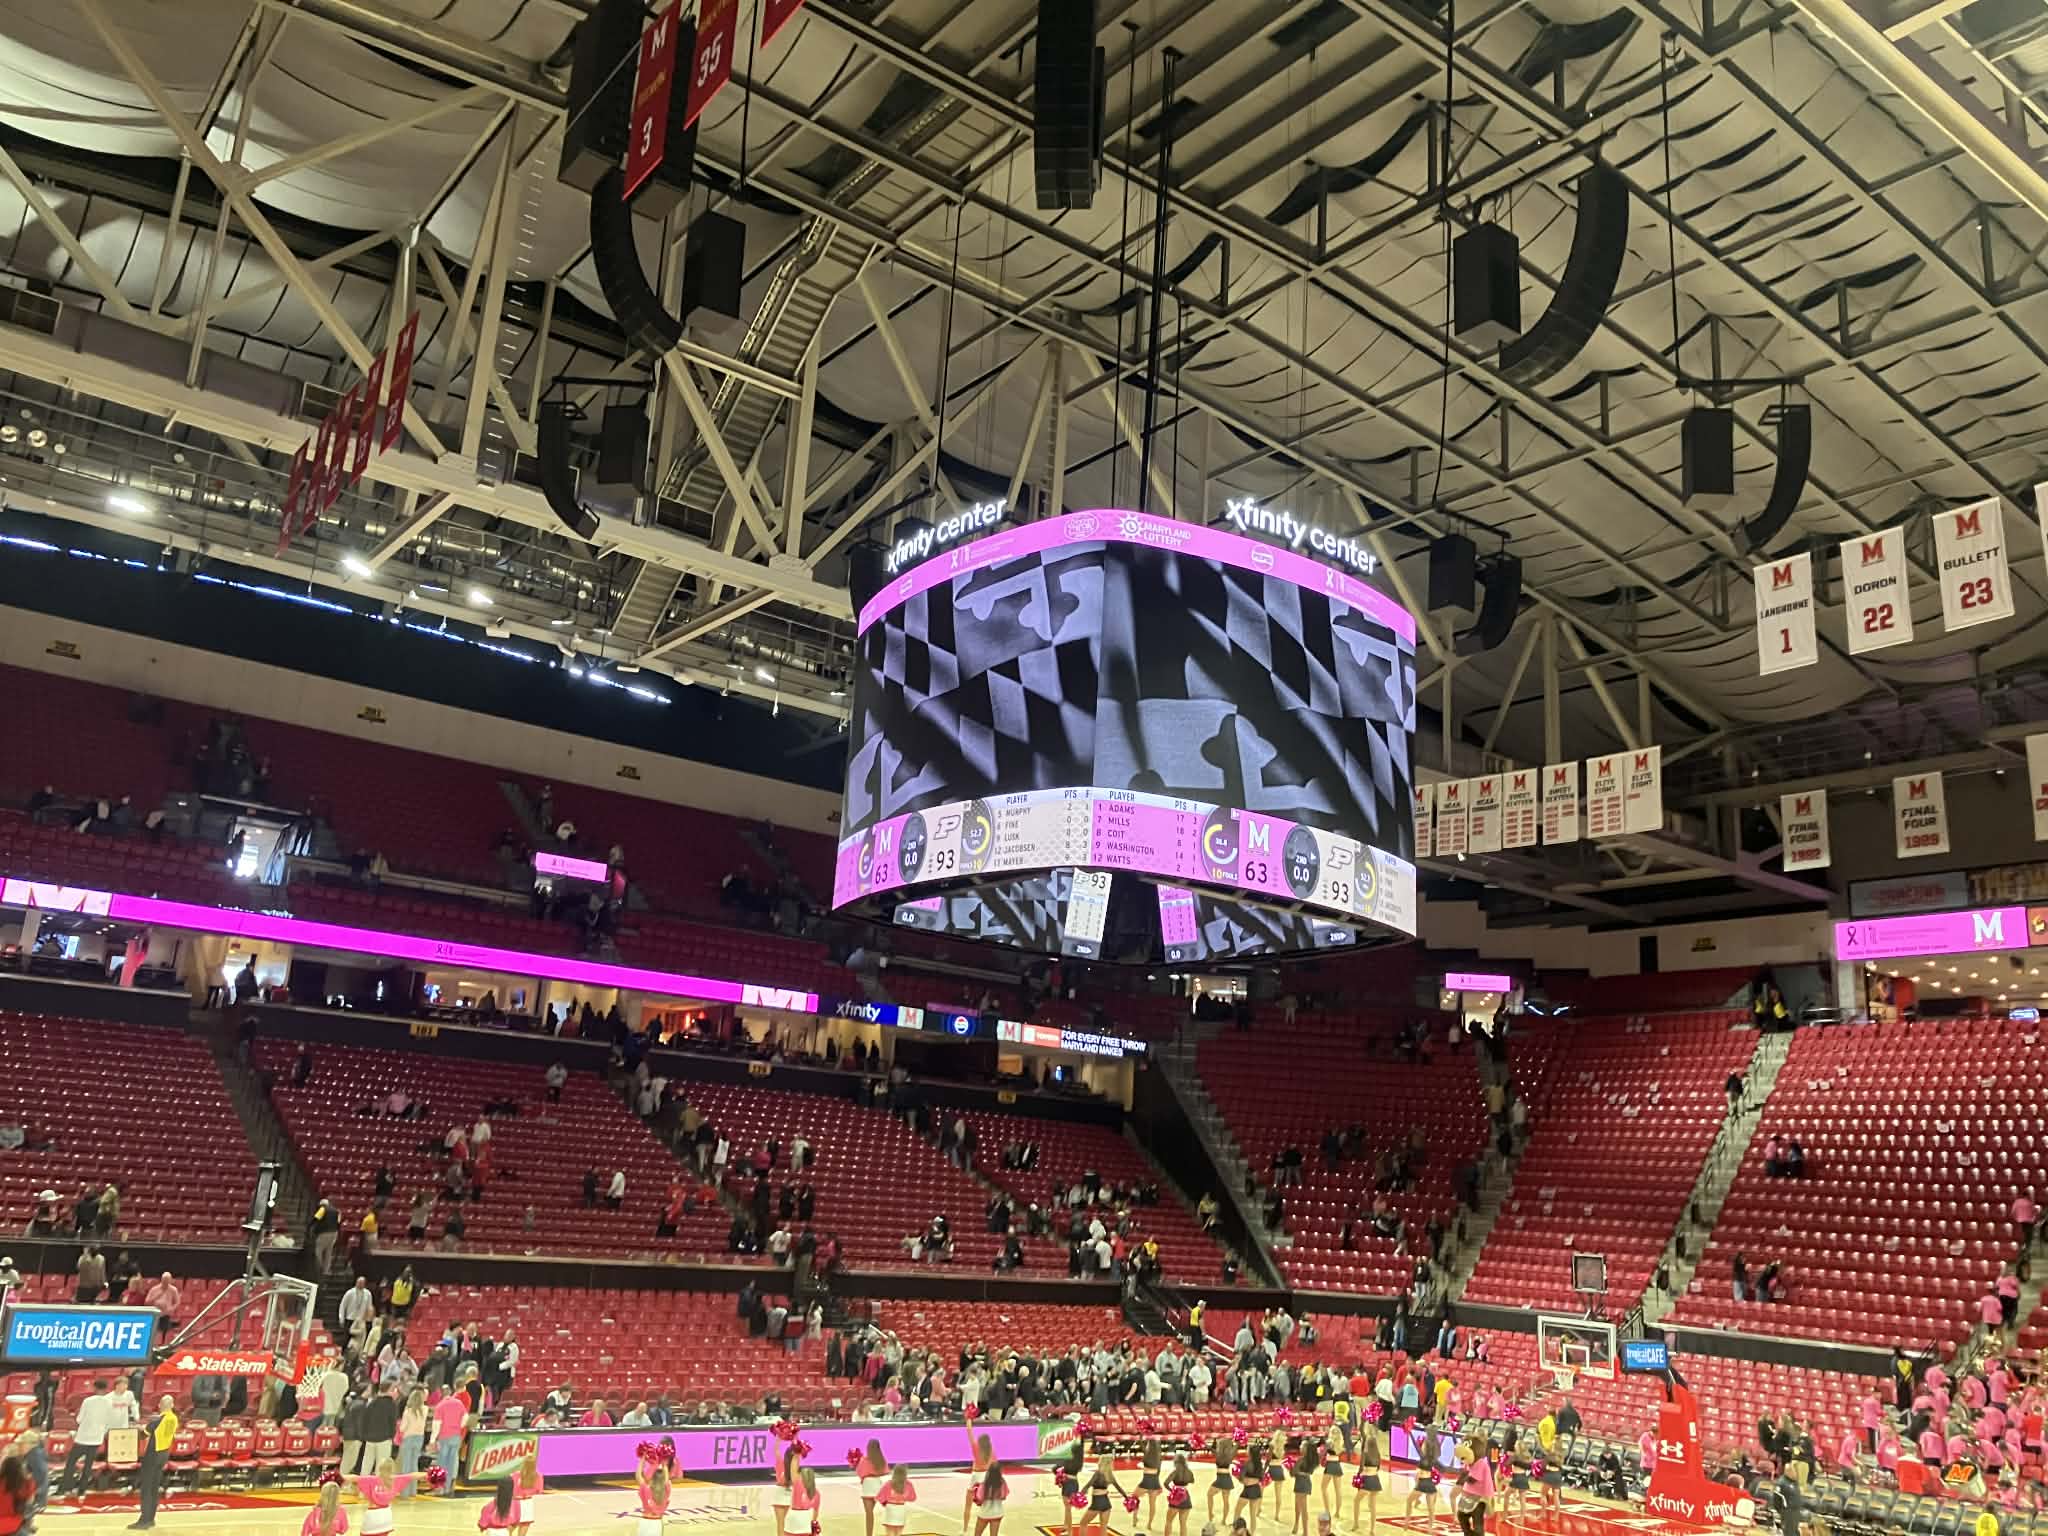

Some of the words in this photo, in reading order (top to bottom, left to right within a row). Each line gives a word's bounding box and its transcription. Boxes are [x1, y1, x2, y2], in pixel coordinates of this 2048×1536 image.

[697, 31, 723, 87] 35
[641, 116, 653, 157] 3
[1143, 521, 1191, 540] MARYLAND
[1955, 509, 1981, 535] M
[888, 527, 935, 573] xfinity
[937, 499, 1007, 542] center
[1143, 531, 1182, 546] LOTTERY
[1225, 497, 1306, 548] xfinity
[1309, 527, 1376, 575] center
[1861, 536, 1884, 562] M
[1944, 546, 2000, 570] BULLETT
[1773, 562, 1792, 587] M
[1854, 576, 1896, 595] DORON
[1960, 577, 1993, 610] 23
[1863, 603, 1895, 634] 22
[1781, 628, 1792, 654] 1
[1599, 759, 1610, 777] M
[1635, 752, 1648, 770] M
[1513, 774, 1526, 790] M
[1554, 768, 1566, 785] M
[1007, 794, 1028, 805] PLAYER
[1065, 789, 1077, 799] PTS
[1448, 784, 1459, 800] M
[1908, 779, 1927, 800] M
[1108, 804, 1135, 814] ADAMS
[1109, 790, 1135, 801] PLAYER
[1175, 800, 1187, 810] PTS
[1005, 808, 1031, 817] MURPHY
[1108, 817, 1130, 826] MILLS
[1902, 805, 1939, 818] FINAL
[933, 814, 961, 840] P
[1107, 829, 1125, 838] COIT
[1904, 817, 1937, 831] FOUR
[879, 826, 893, 855] M
[1248, 820, 1270, 852] M
[1095, 841, 1100, 849] 9
[1106, 841, 1155, 855] WASHINGTON
[1327, 846, 1354, 869] P
[904, 852, 918, 867] 0.0
[936, 849, 955, 871] 93
[1106, 855, 1131, 865] WATTS
[875, 864, 888, 885] 63
[1091, 874, 1106, 889] 93
[1245, 861, 1268, 883] 63
[1293, 867, 1310, 882] 0.0
[1332, 880, 1349, 904] 93
[902, 911, 914, 923] 0.0
[1972, 911, 2004, 943] M
[1171, 949, 1181, 960] 0.0
[836, 1000, 881, 1021] xfinity
[905, 1008, 917, 1025] M
[1004, 1023, 1016, 1038] M
[1061, 1030, 1077, 1041] FOR
[1078, 1032, 1101, 1045] EVERY
[1101, 1036, 1120, 1048] FREE
[1121, 1038, 1146, 1051] THROW
[1061, 1040, 1099, 1053] MARYLAND
[1099, 1045, 1123, 1057] MAKES
[15, 1321, 87, 1344] tropical
[85, 1321, 145, 1350] CAFE
[47, 1340, 84, 1350] SMOOTHIE
[1647, 1347, 1664, 1363] CAFE
[14, 1407, 25, 1420] G
[471, 1439, 536, 1476] LIBMAN
[713, 1435, 767, 1464] FEAR
[1945, 1463, 1975, 1484] M
[1649, 1493, 1695, 1519] xfinity
[1704, 1499, 1733, 1520] xfinity
